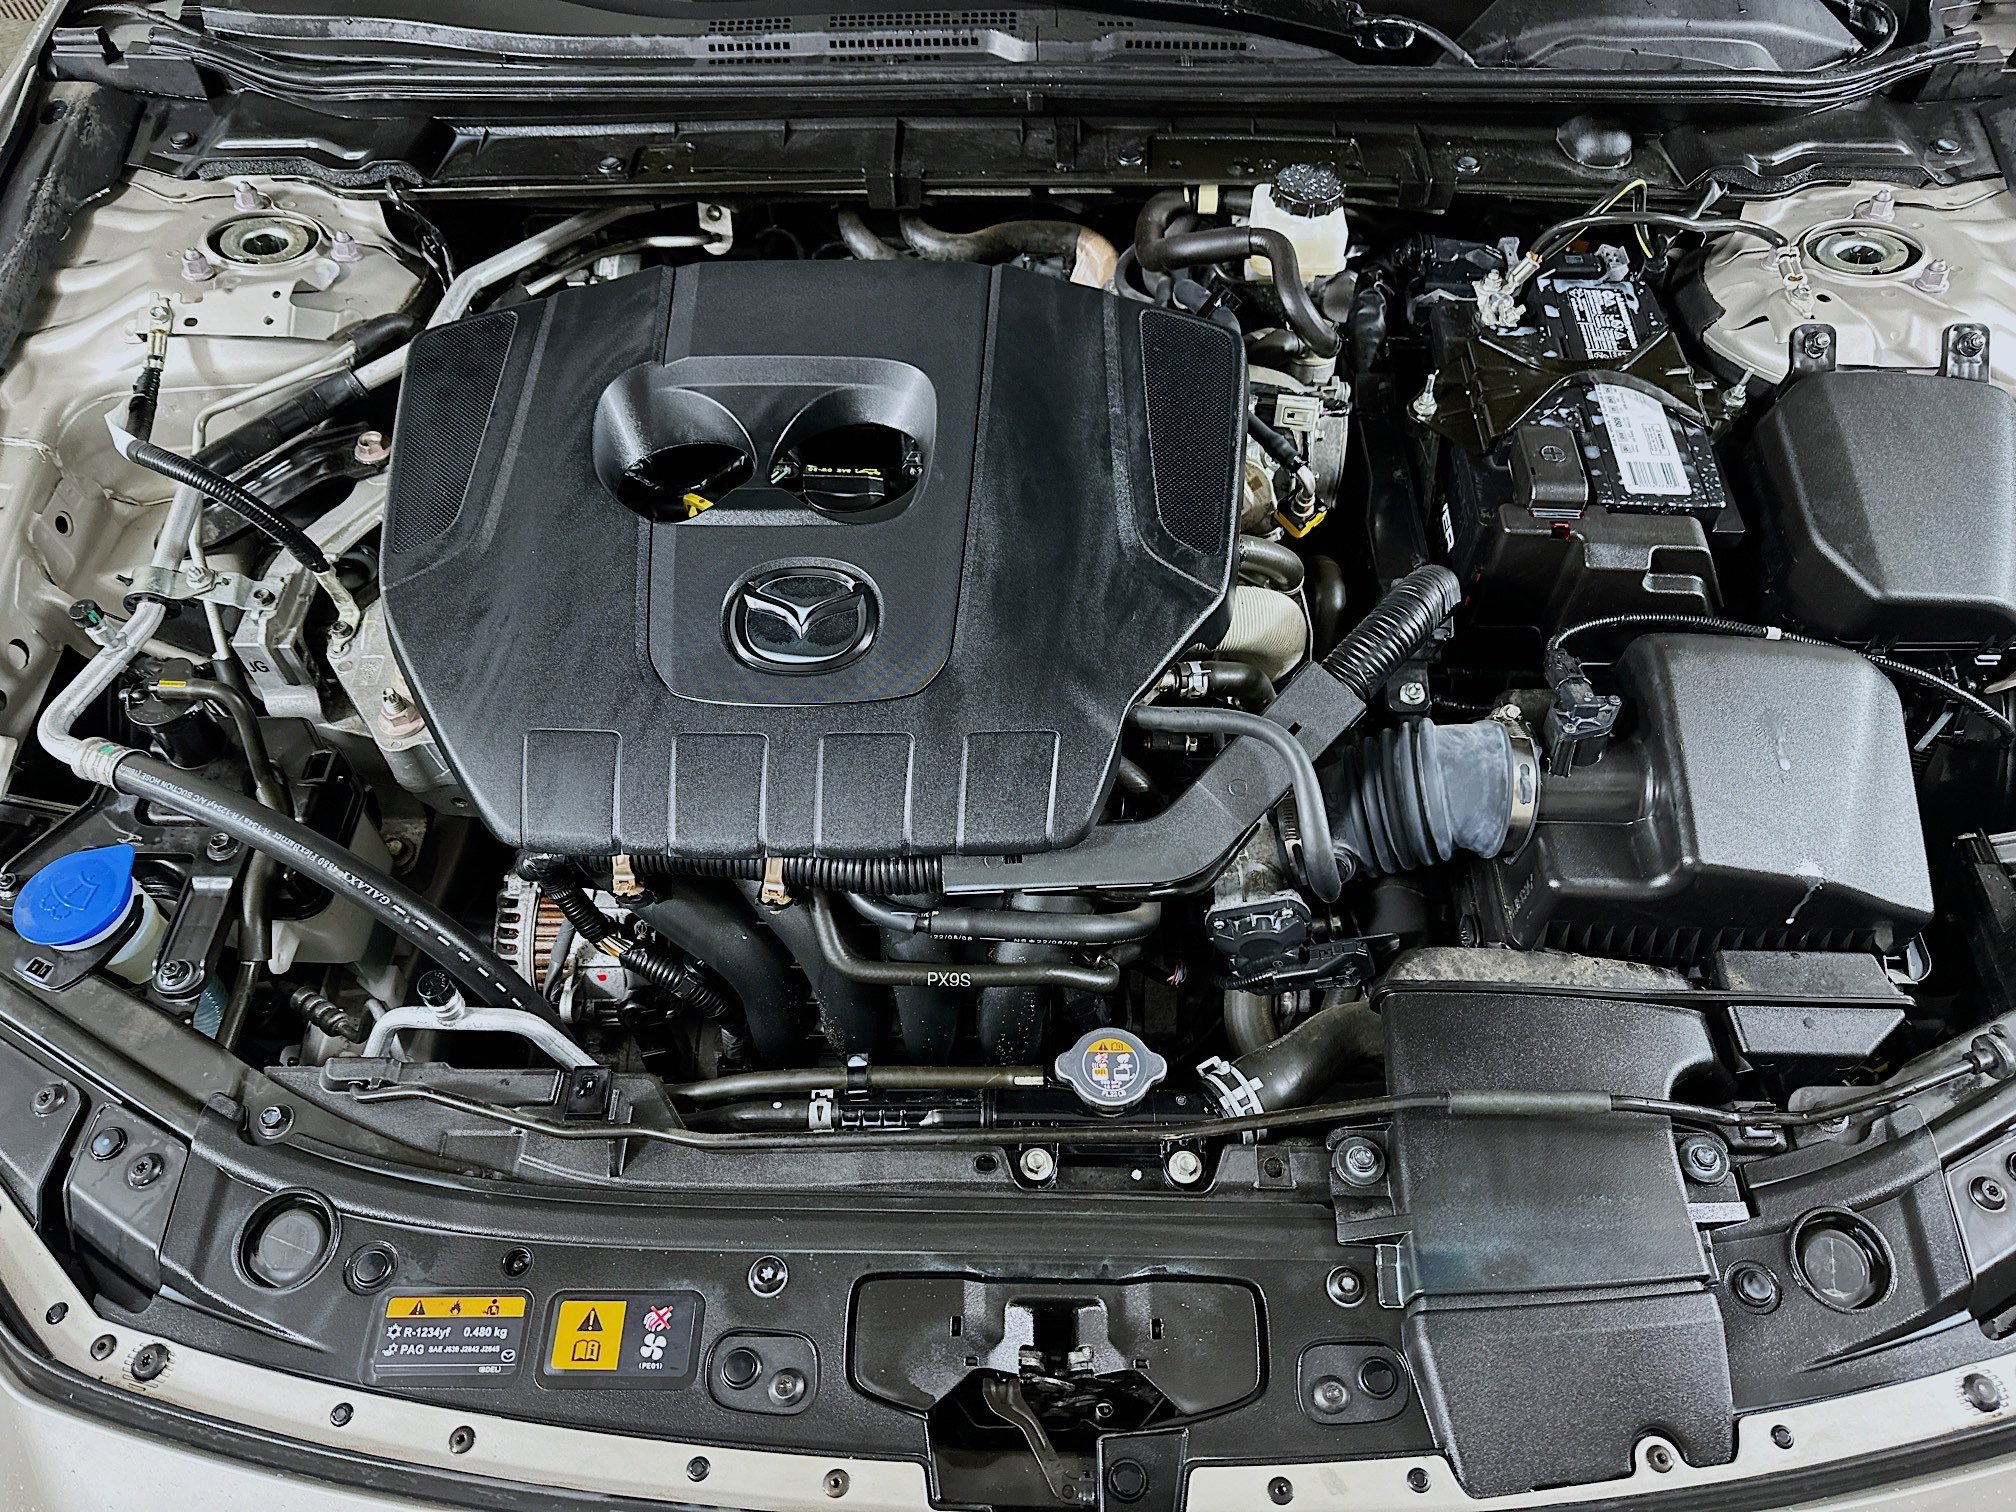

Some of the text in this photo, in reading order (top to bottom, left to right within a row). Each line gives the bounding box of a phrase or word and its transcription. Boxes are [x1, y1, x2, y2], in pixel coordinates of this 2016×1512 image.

[140, 770, 160, 786] HOSE
[160, 780, 194, 799] SUCTION
[927, 972, 971, 987] PX9S
[403, 1326, 508, 1339] R-1234yf 0.480 kg
[400, 1344, 424, 1355] PAG
